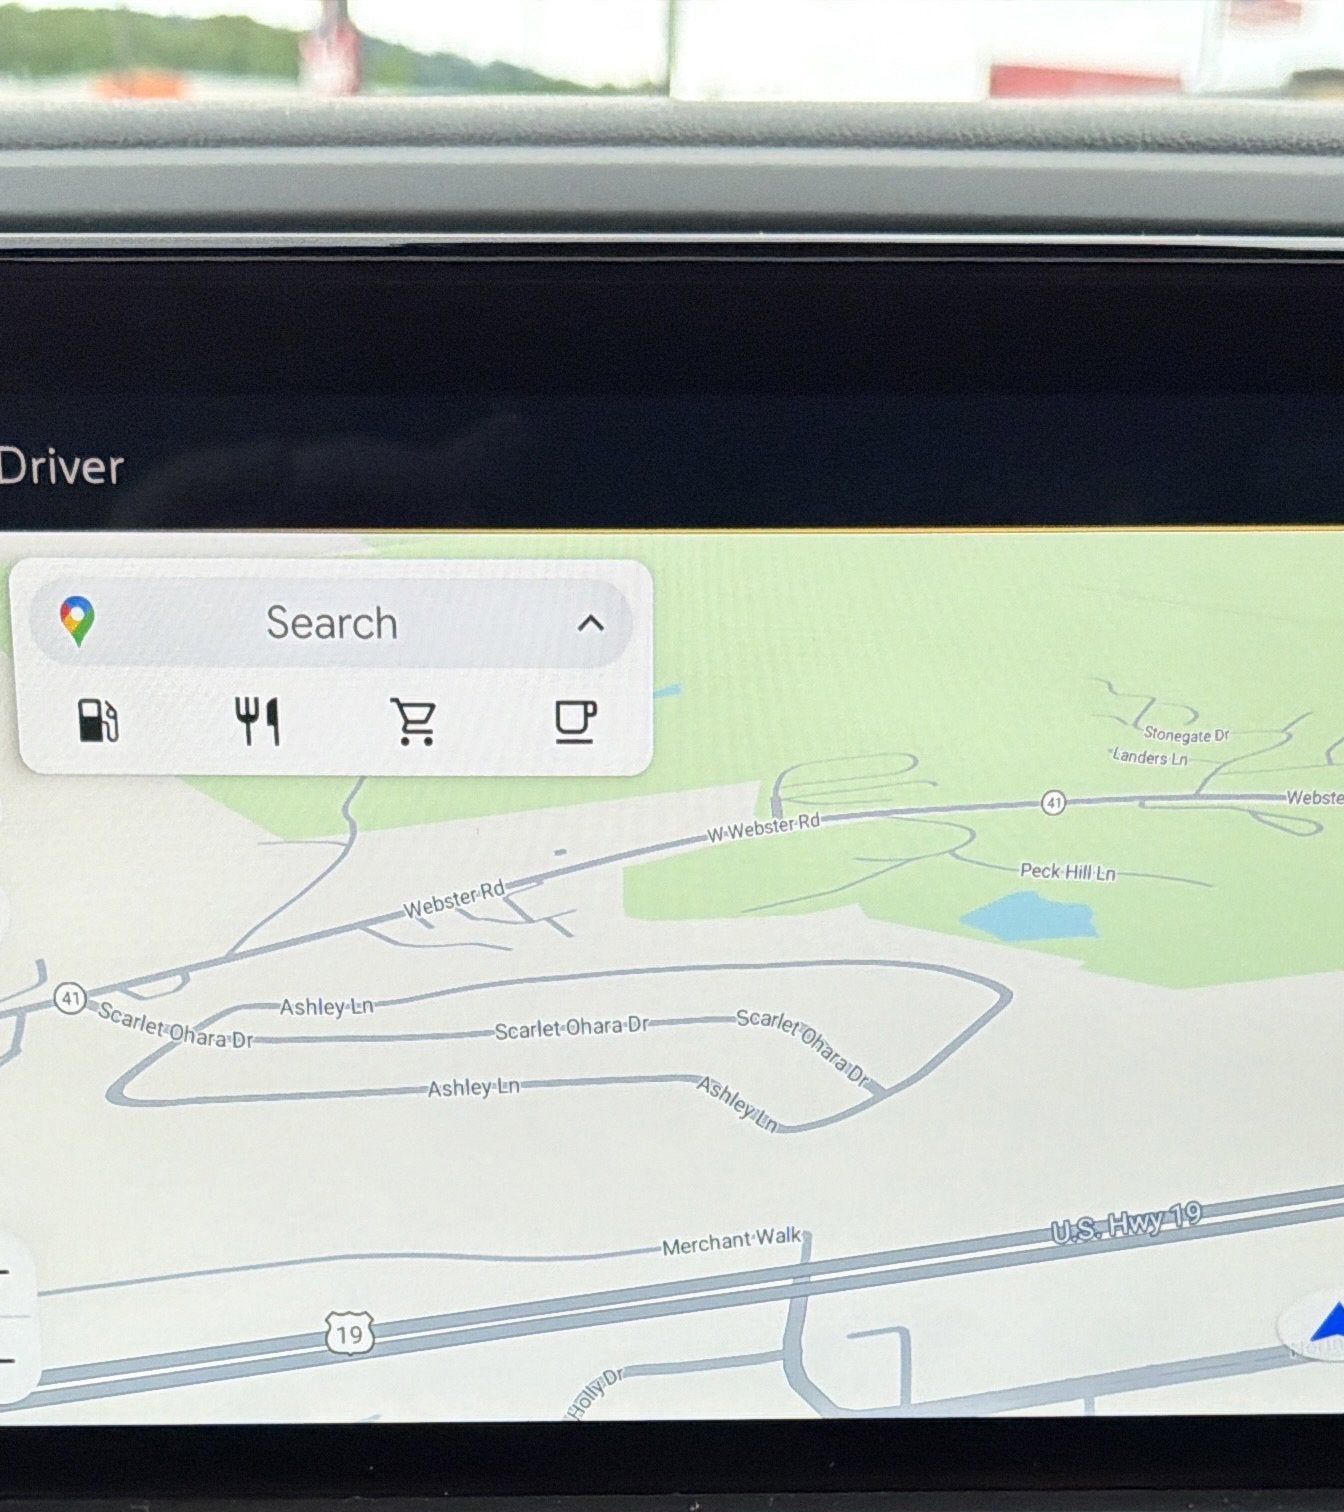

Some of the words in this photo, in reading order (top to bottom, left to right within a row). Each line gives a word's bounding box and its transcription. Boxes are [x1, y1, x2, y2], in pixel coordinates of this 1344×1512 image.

[265, 604, 399, 641] Search
[1144, 726, 1212, 746] Stonegate
[1215, 728, 1230, 741] Dr
[1113, 746, 1168, 765] Landers
[1171, 753, 1188, 766] Ln
[1046, 797, 1062, 809] 41
[706, 828, 725, 843] W
[725, 818, 795, 841] Webster
[797, 811, 822, 831] Rd
[1020, 863, 1060, 878] Peck
[1065, 865, 1092, 880] Hill
[1096, 866, 1117, 881] Ln
[403, 892, 478, 919] Webster
[480, 878, 506, 900] Rd
[61, 991, 81, 1006] 41
[279, 998, 344, 1020] Ashley
[350, 998, 374, 1015] Ln
[97, 1001, 165, 1037] Scarlet
[169, 1023, 227, 1048] Ohara
[232, 1031, 254, 1049] Dr
[495, 1019, 561, 1041] Scarlet
[566, 1017, 623, 1036] Ohara
[627, 1015, 649, 1033] Dr
[736, 1009, 800, 1037] Scarlet
[801, 1027, 848, 1072] Ohara
[846, 1065, 869, 1088] Dr
[428, 1077, 493, 1100] Ashley
[497, 1077, 520, 1094] Ln
[696, 1076, 753, 1120] Ashley
[754, 1110, 778, 1134] Ln
[1050, 1216, 1103, 1246] U.S.
[1107, 1211, 1164, 1240] Hwy
[1169, 1201, 1204, 1227] 19
[662, 1230, 752, 1257] Merchant
[756, 1225, 803, 1246] Walk
[337, 1325, 363, 1345] 19
[567, 1380, 605, 1422] Holly
[602, 1368, 623, 1386] Dr
